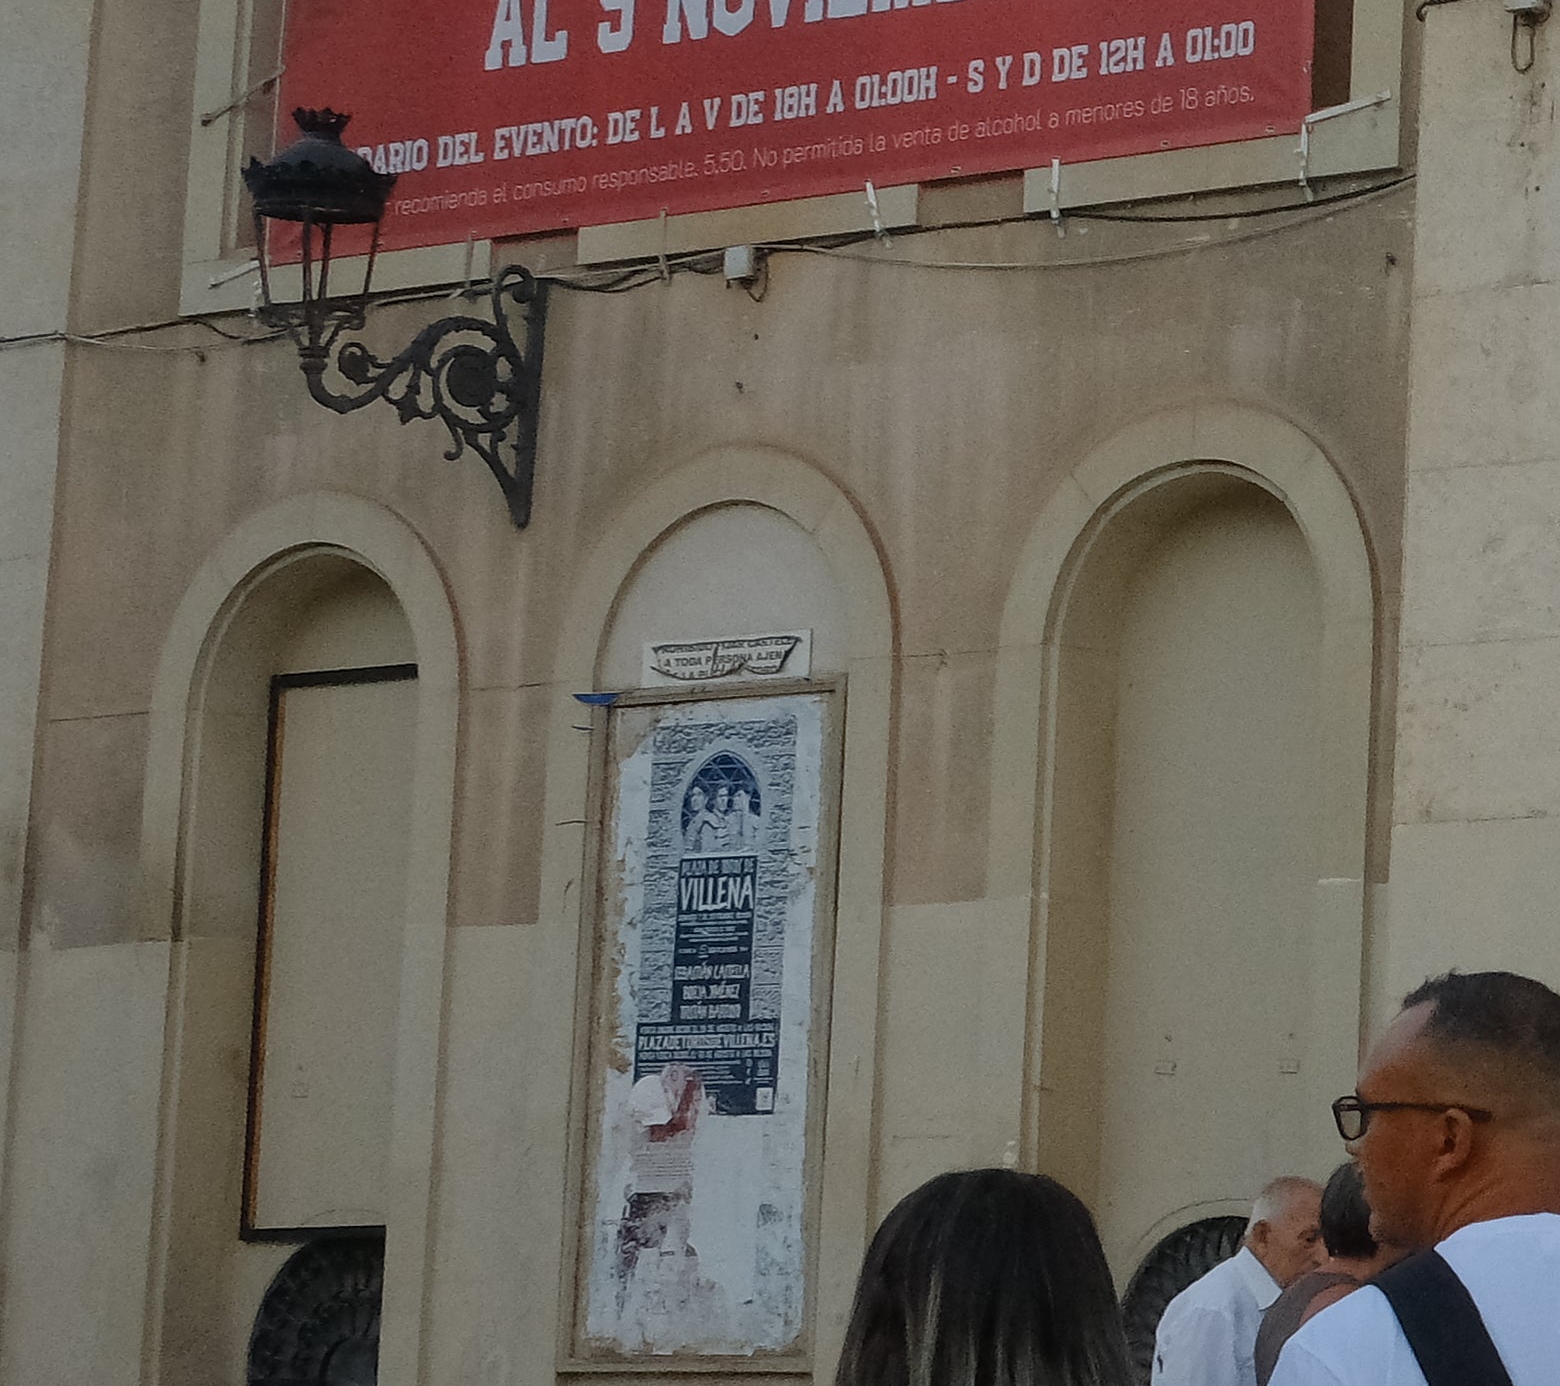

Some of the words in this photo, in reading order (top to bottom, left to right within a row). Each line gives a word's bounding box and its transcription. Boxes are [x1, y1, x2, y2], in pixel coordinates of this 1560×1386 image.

[395, 186, 489, 216] recomienda
[493, 184, 508, 204] el
[513, 174, 587, 201] consumo
[752, 145, 779, 169] No
[783, 131, 864, 167] permitida
[867, 130, 887, 153] la
[892, 126, 943, 150] venta
[947, 119, 970, 143] de
[975, 108, 1043, 138] alcohol
[1047, 110, 1060, 129] a
[1064, 98, 1146, 127] menores
[1150, 90, 1174, 116] de
[1180, 84, 1201, 111] 18
[436, 131, 485, 169] DEL
[493, 114, 599, 161] EVENTO:
[605, 109, 642, 145] DE
[650, 107, 666, 139] L
[674, 101, 693, 136] A
[703, 97, 722, 131] V
[729, 91, 766, 128] DE
[774, 83, 819, 122] 18H
[825, 80, 846, 114] A
[854, 65, 938, 110] 01:00H
[966, 59, 986, 94] S
[994, 56, 1014, 90] Y
[1022, 51, 1042, 87] D
[1052, 44, 1090, 83] DE
[1099, 35, 1147, 76] 12H
[1155, 32, 1175, 68] A
[1185, 19, 1256, 61] 01:00
[680, 873, 754, 912] VILLENA
